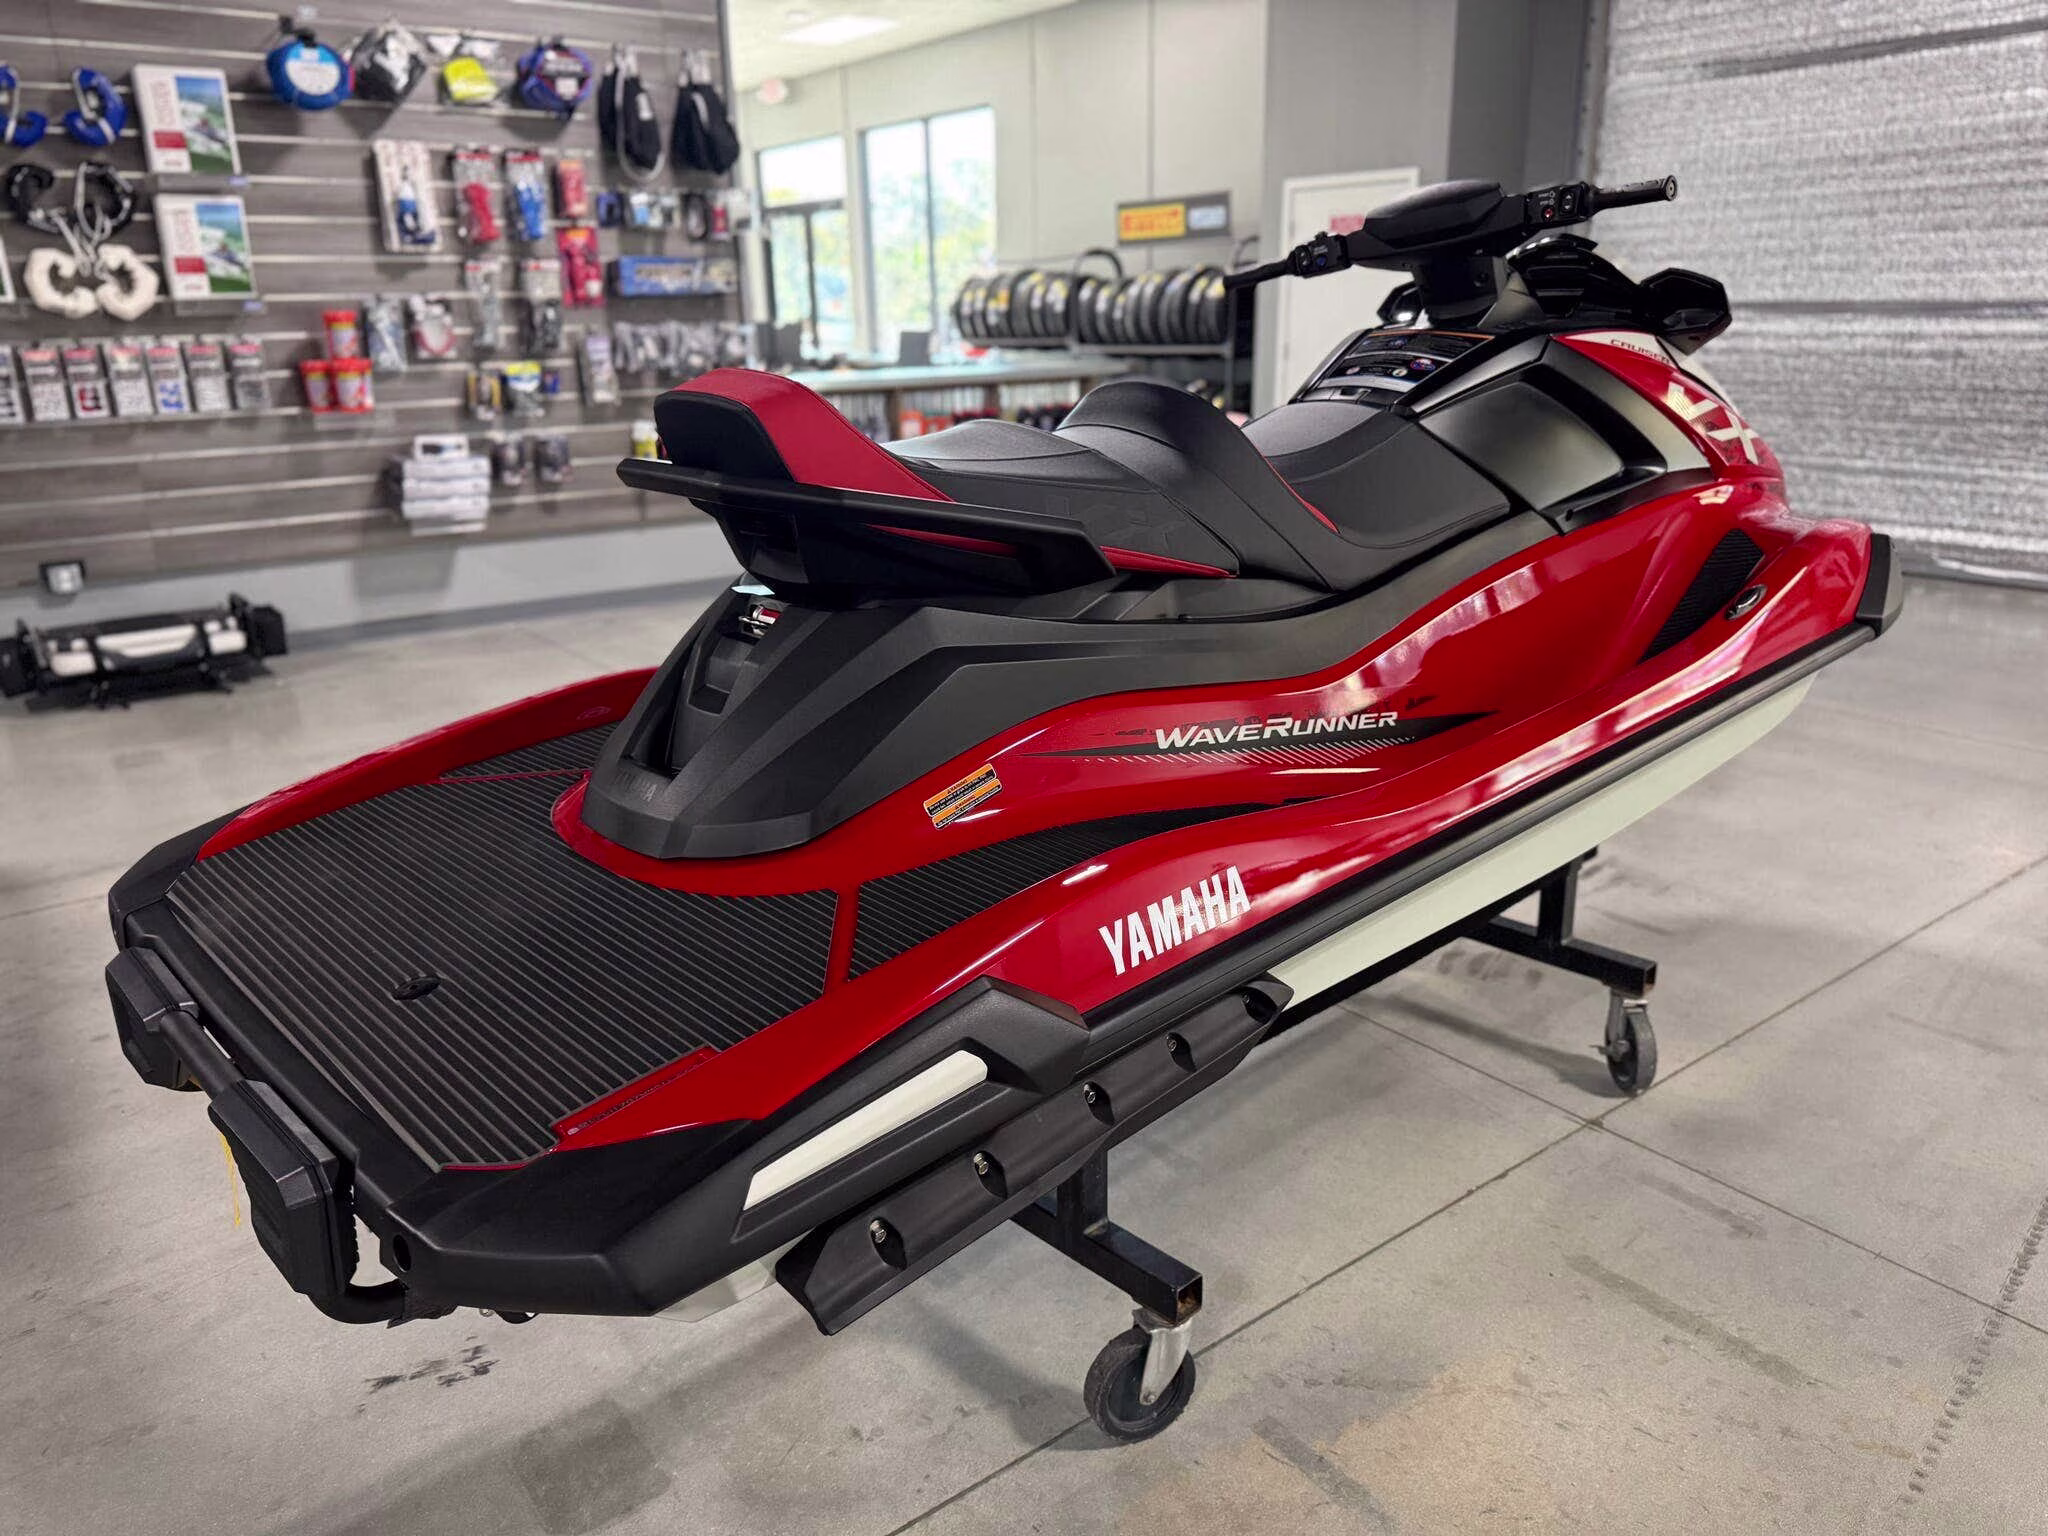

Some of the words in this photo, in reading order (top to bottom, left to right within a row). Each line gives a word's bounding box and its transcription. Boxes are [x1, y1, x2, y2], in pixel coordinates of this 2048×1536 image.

[1610, 339, 1670, 364] CRUISER
[1662, 381, 1759, 466] VX
[1098, 865, 1251, 976] YAMAHA
